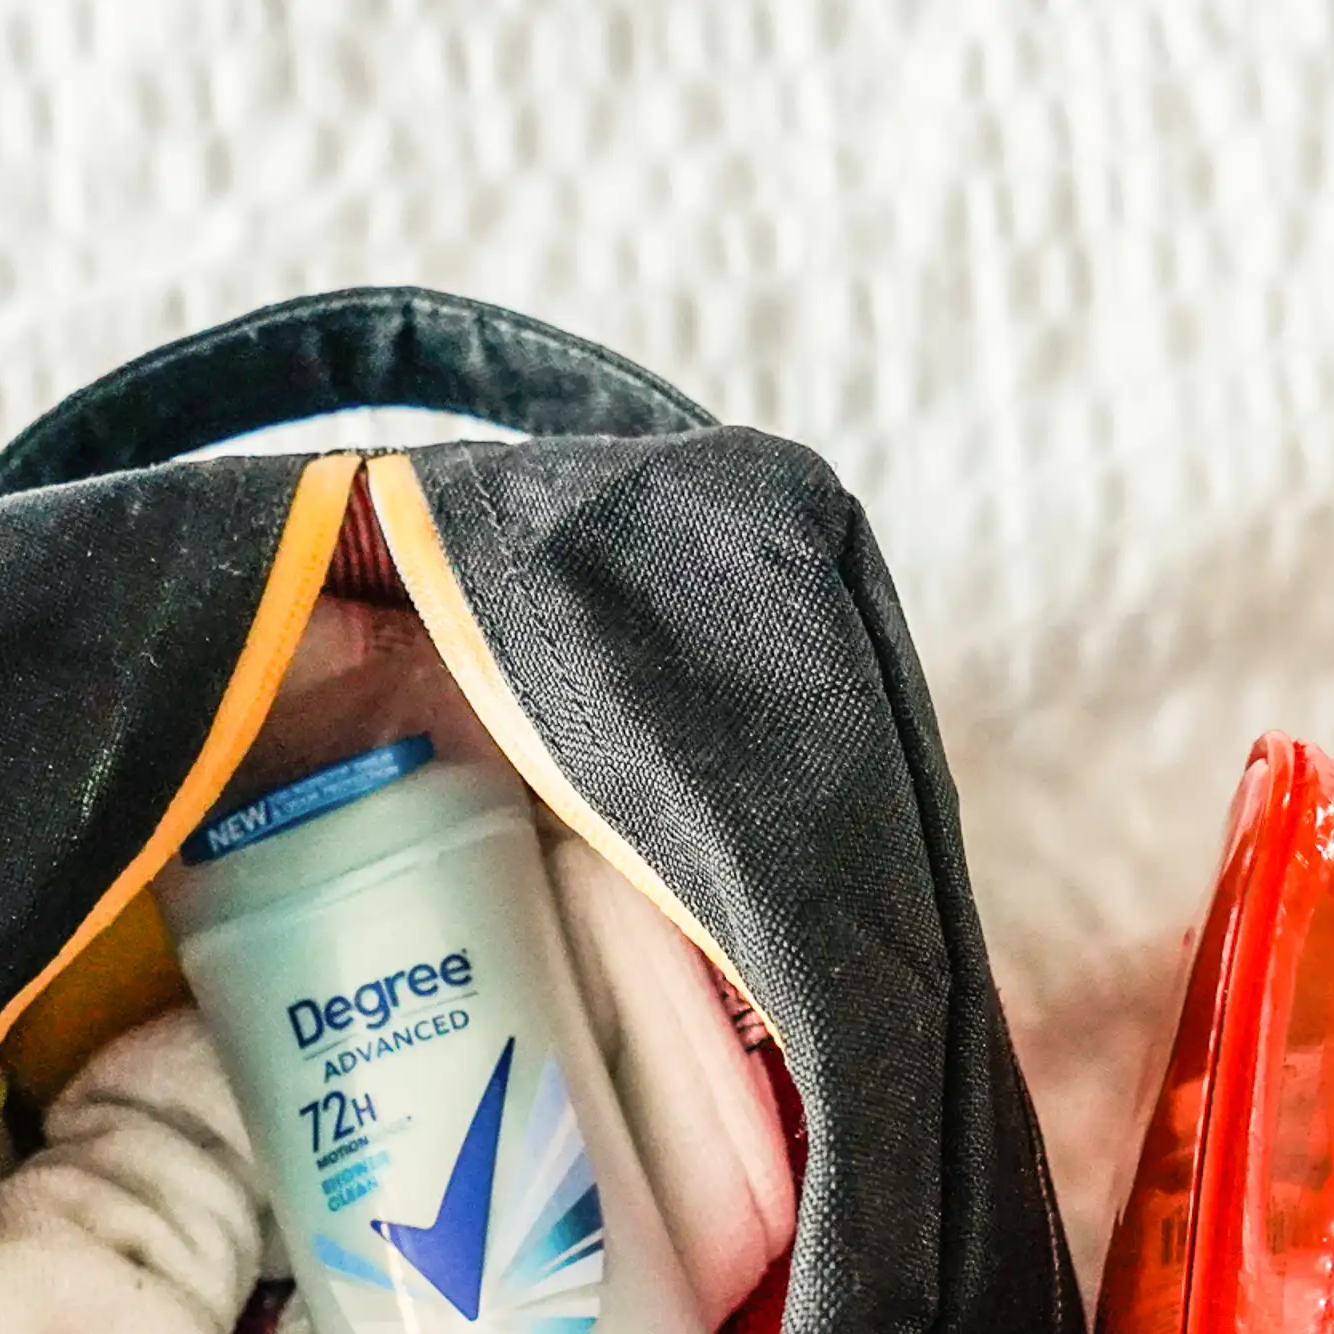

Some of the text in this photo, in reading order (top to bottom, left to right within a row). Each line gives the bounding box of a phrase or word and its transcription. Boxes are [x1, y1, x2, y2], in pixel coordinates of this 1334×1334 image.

[206, 802, 266, 853] NEW
[287, 950, 473, 1049] Degree
[324, 1009, 470, 1083] ADVANCED
[299, 1090, 377, 1153] 72H
